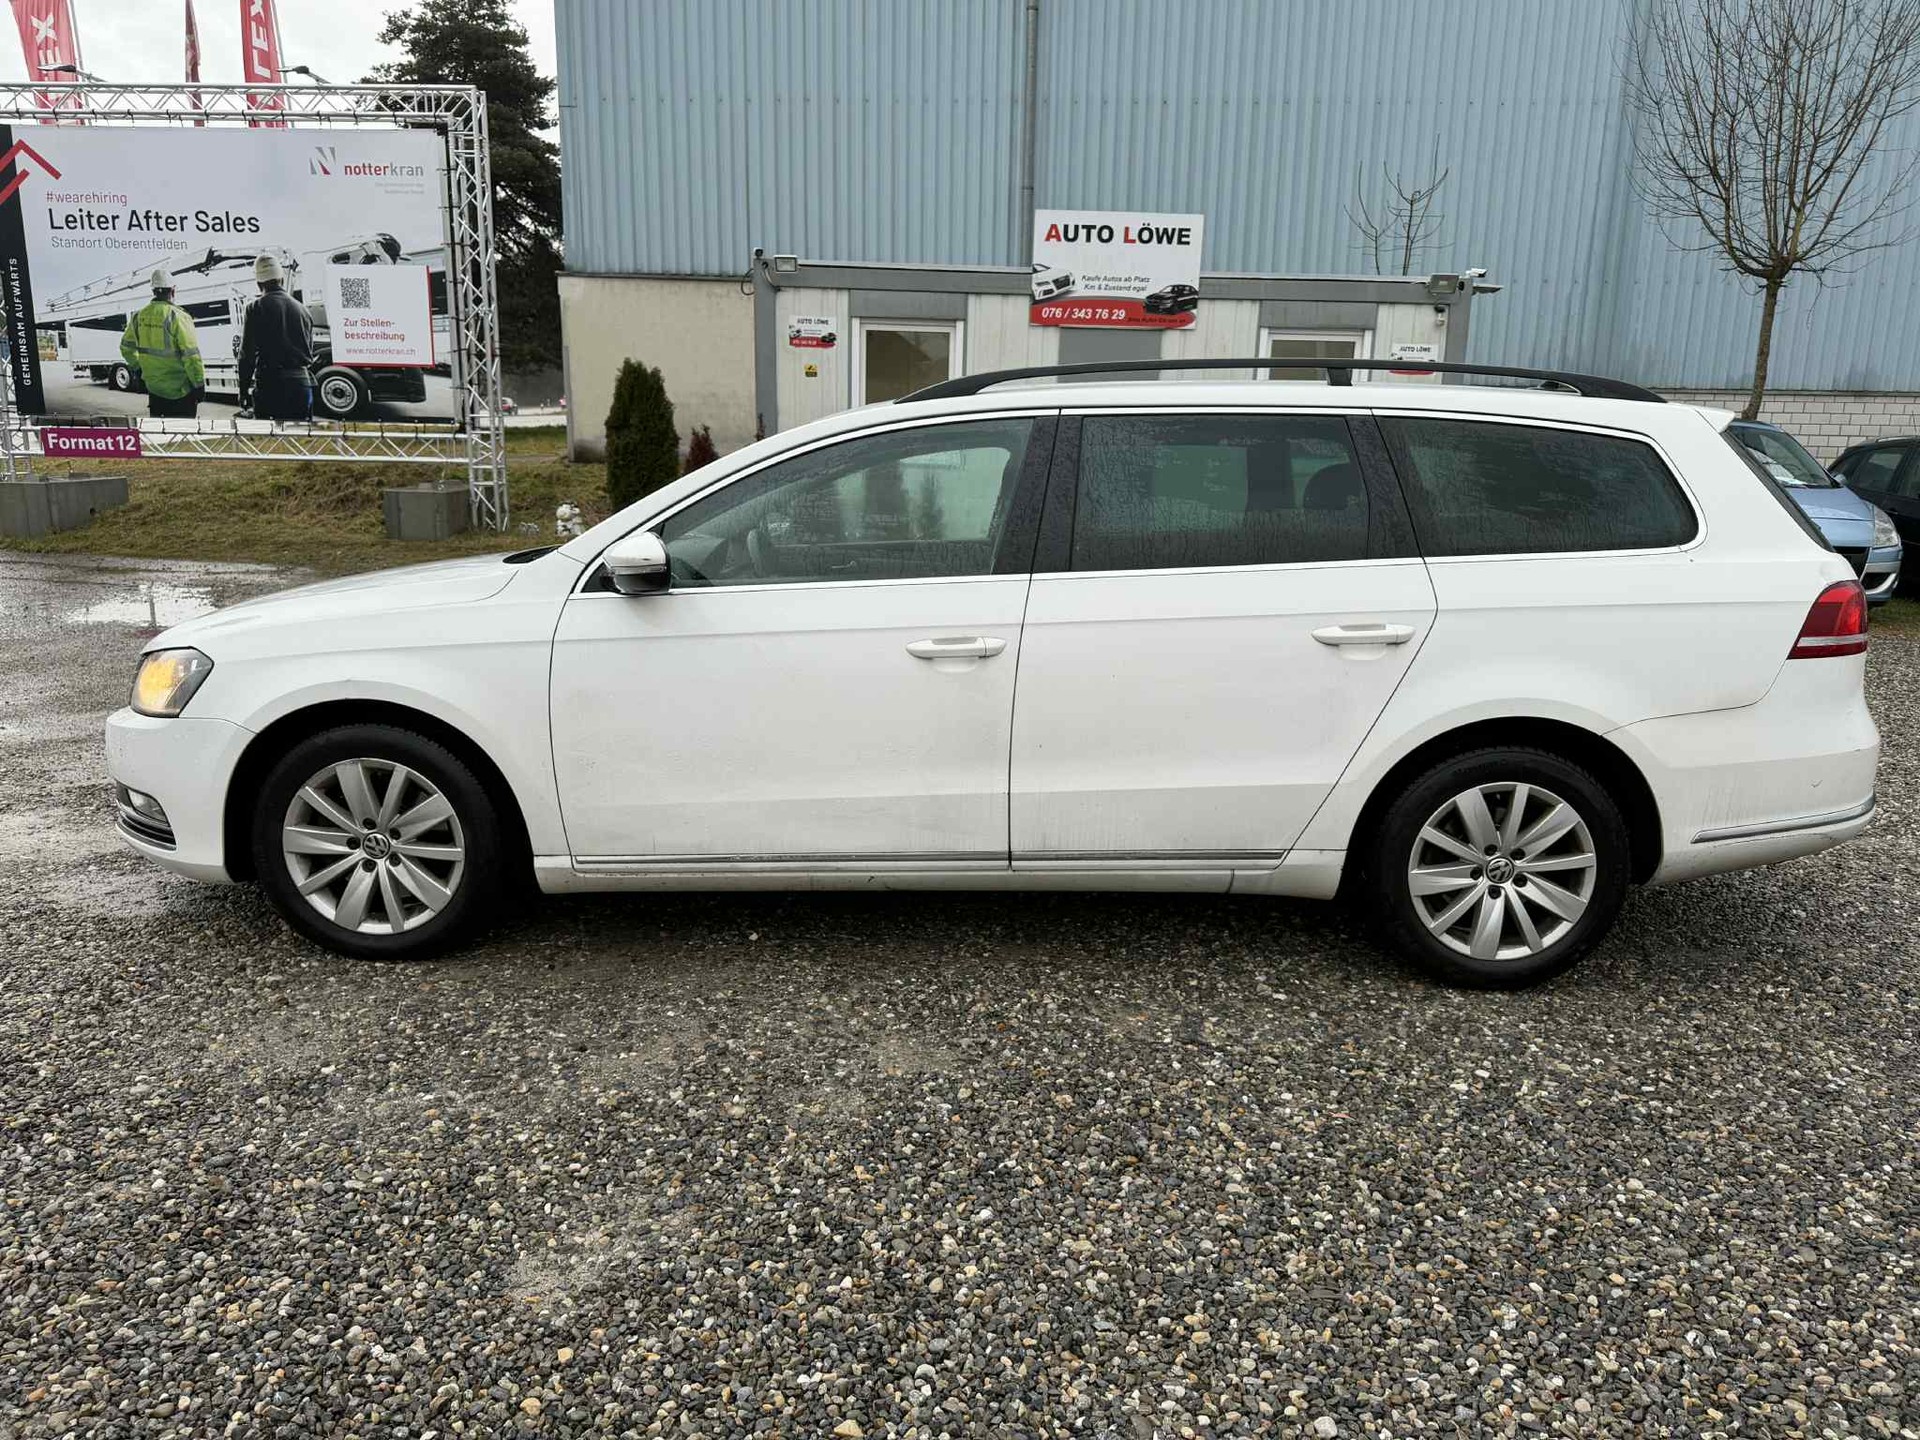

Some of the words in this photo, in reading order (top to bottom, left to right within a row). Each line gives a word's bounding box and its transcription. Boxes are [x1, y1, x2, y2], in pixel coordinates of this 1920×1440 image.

[344, 161, 424, 176] notterkran
[46, 191, 128, 207] #wearehiring
[48, 208, 120, 231] Leiter
[127, 209, 188, 232] After
[194, 210, 260, 233] Sales
[1045, 223, 1114, 243] AUTO
[1123, 222, 1191, 246] LÖWE
[51, 236, 102, 249] Standort
[105, 237, 188, 250] Oberentfelden
[9, 258, 24, 319] AUFWÄRTS
[1041, 307, 1063, 319] 076
[1063, 307, 1071, 319] /
[1071, 307, 1093, 319] 343
[1095, 308, 1109, 320] 76
[1111, 309, 1126, 320] 29
[344, 318, 358, 327] Zur
[360, 318, 396, 328] Stellen-
[344, 331, 405, 342] beschreibung
[17, 322, 32, 386] GEMEINSAM
[345, 347, 416, 356] www.notterkran.ch
